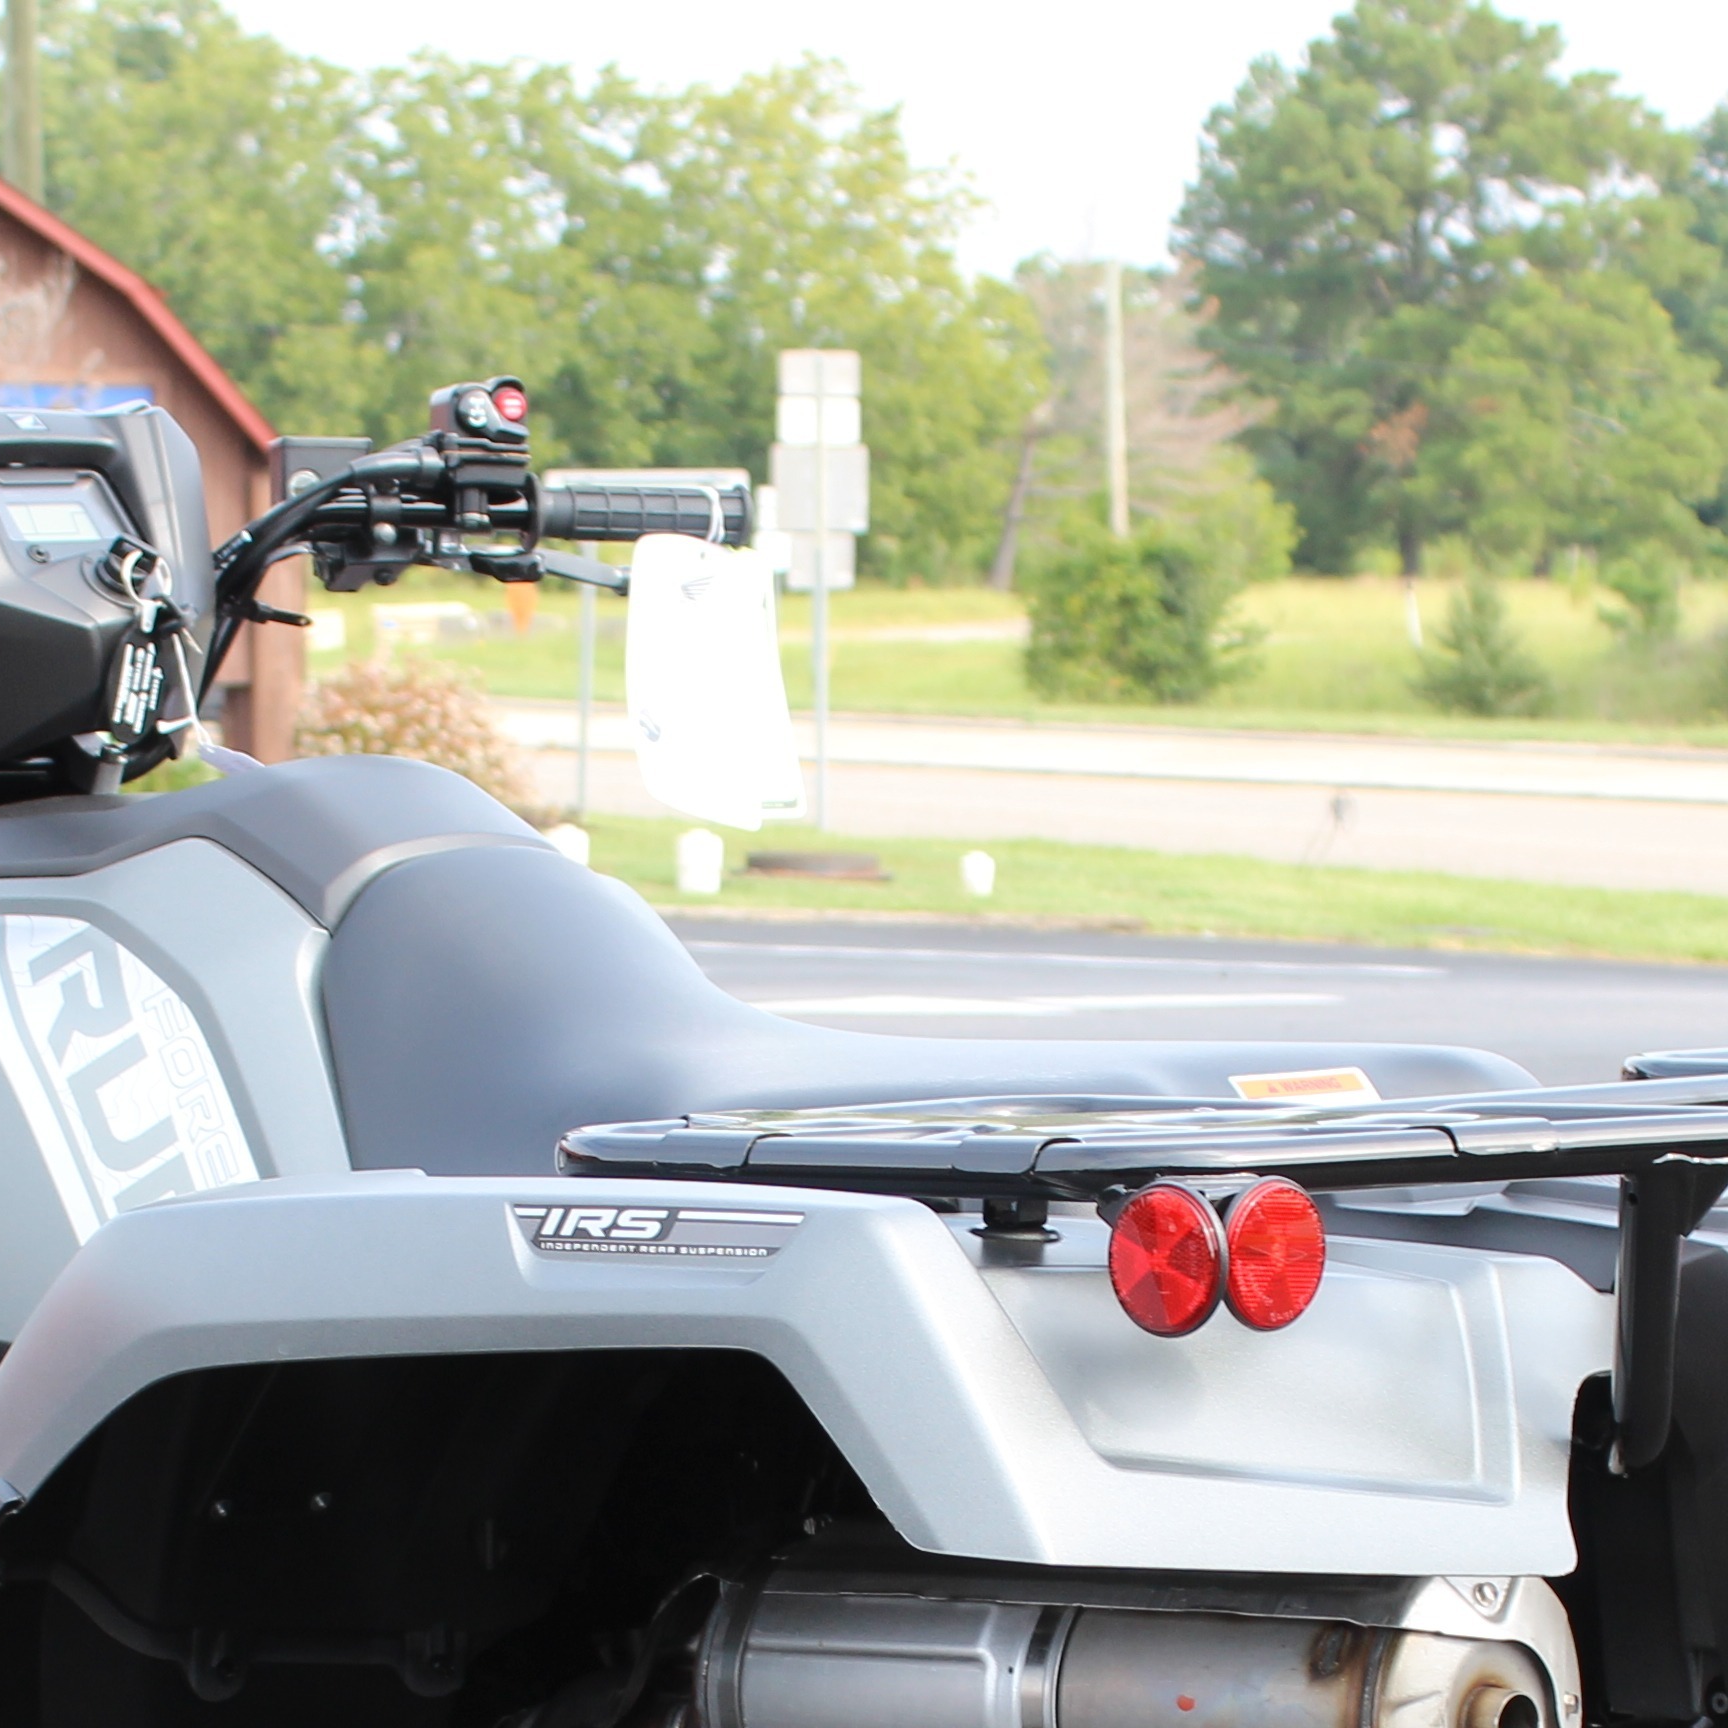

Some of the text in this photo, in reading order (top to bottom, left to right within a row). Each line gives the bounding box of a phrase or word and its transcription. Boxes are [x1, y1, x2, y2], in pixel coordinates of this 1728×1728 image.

[1278, 1077, 1343, 1093] WARNING
[540, 1208, 670, 1239] IRS
[540, 1242, 768, 1257] INDEPENDENT REAR SUSPENSION
